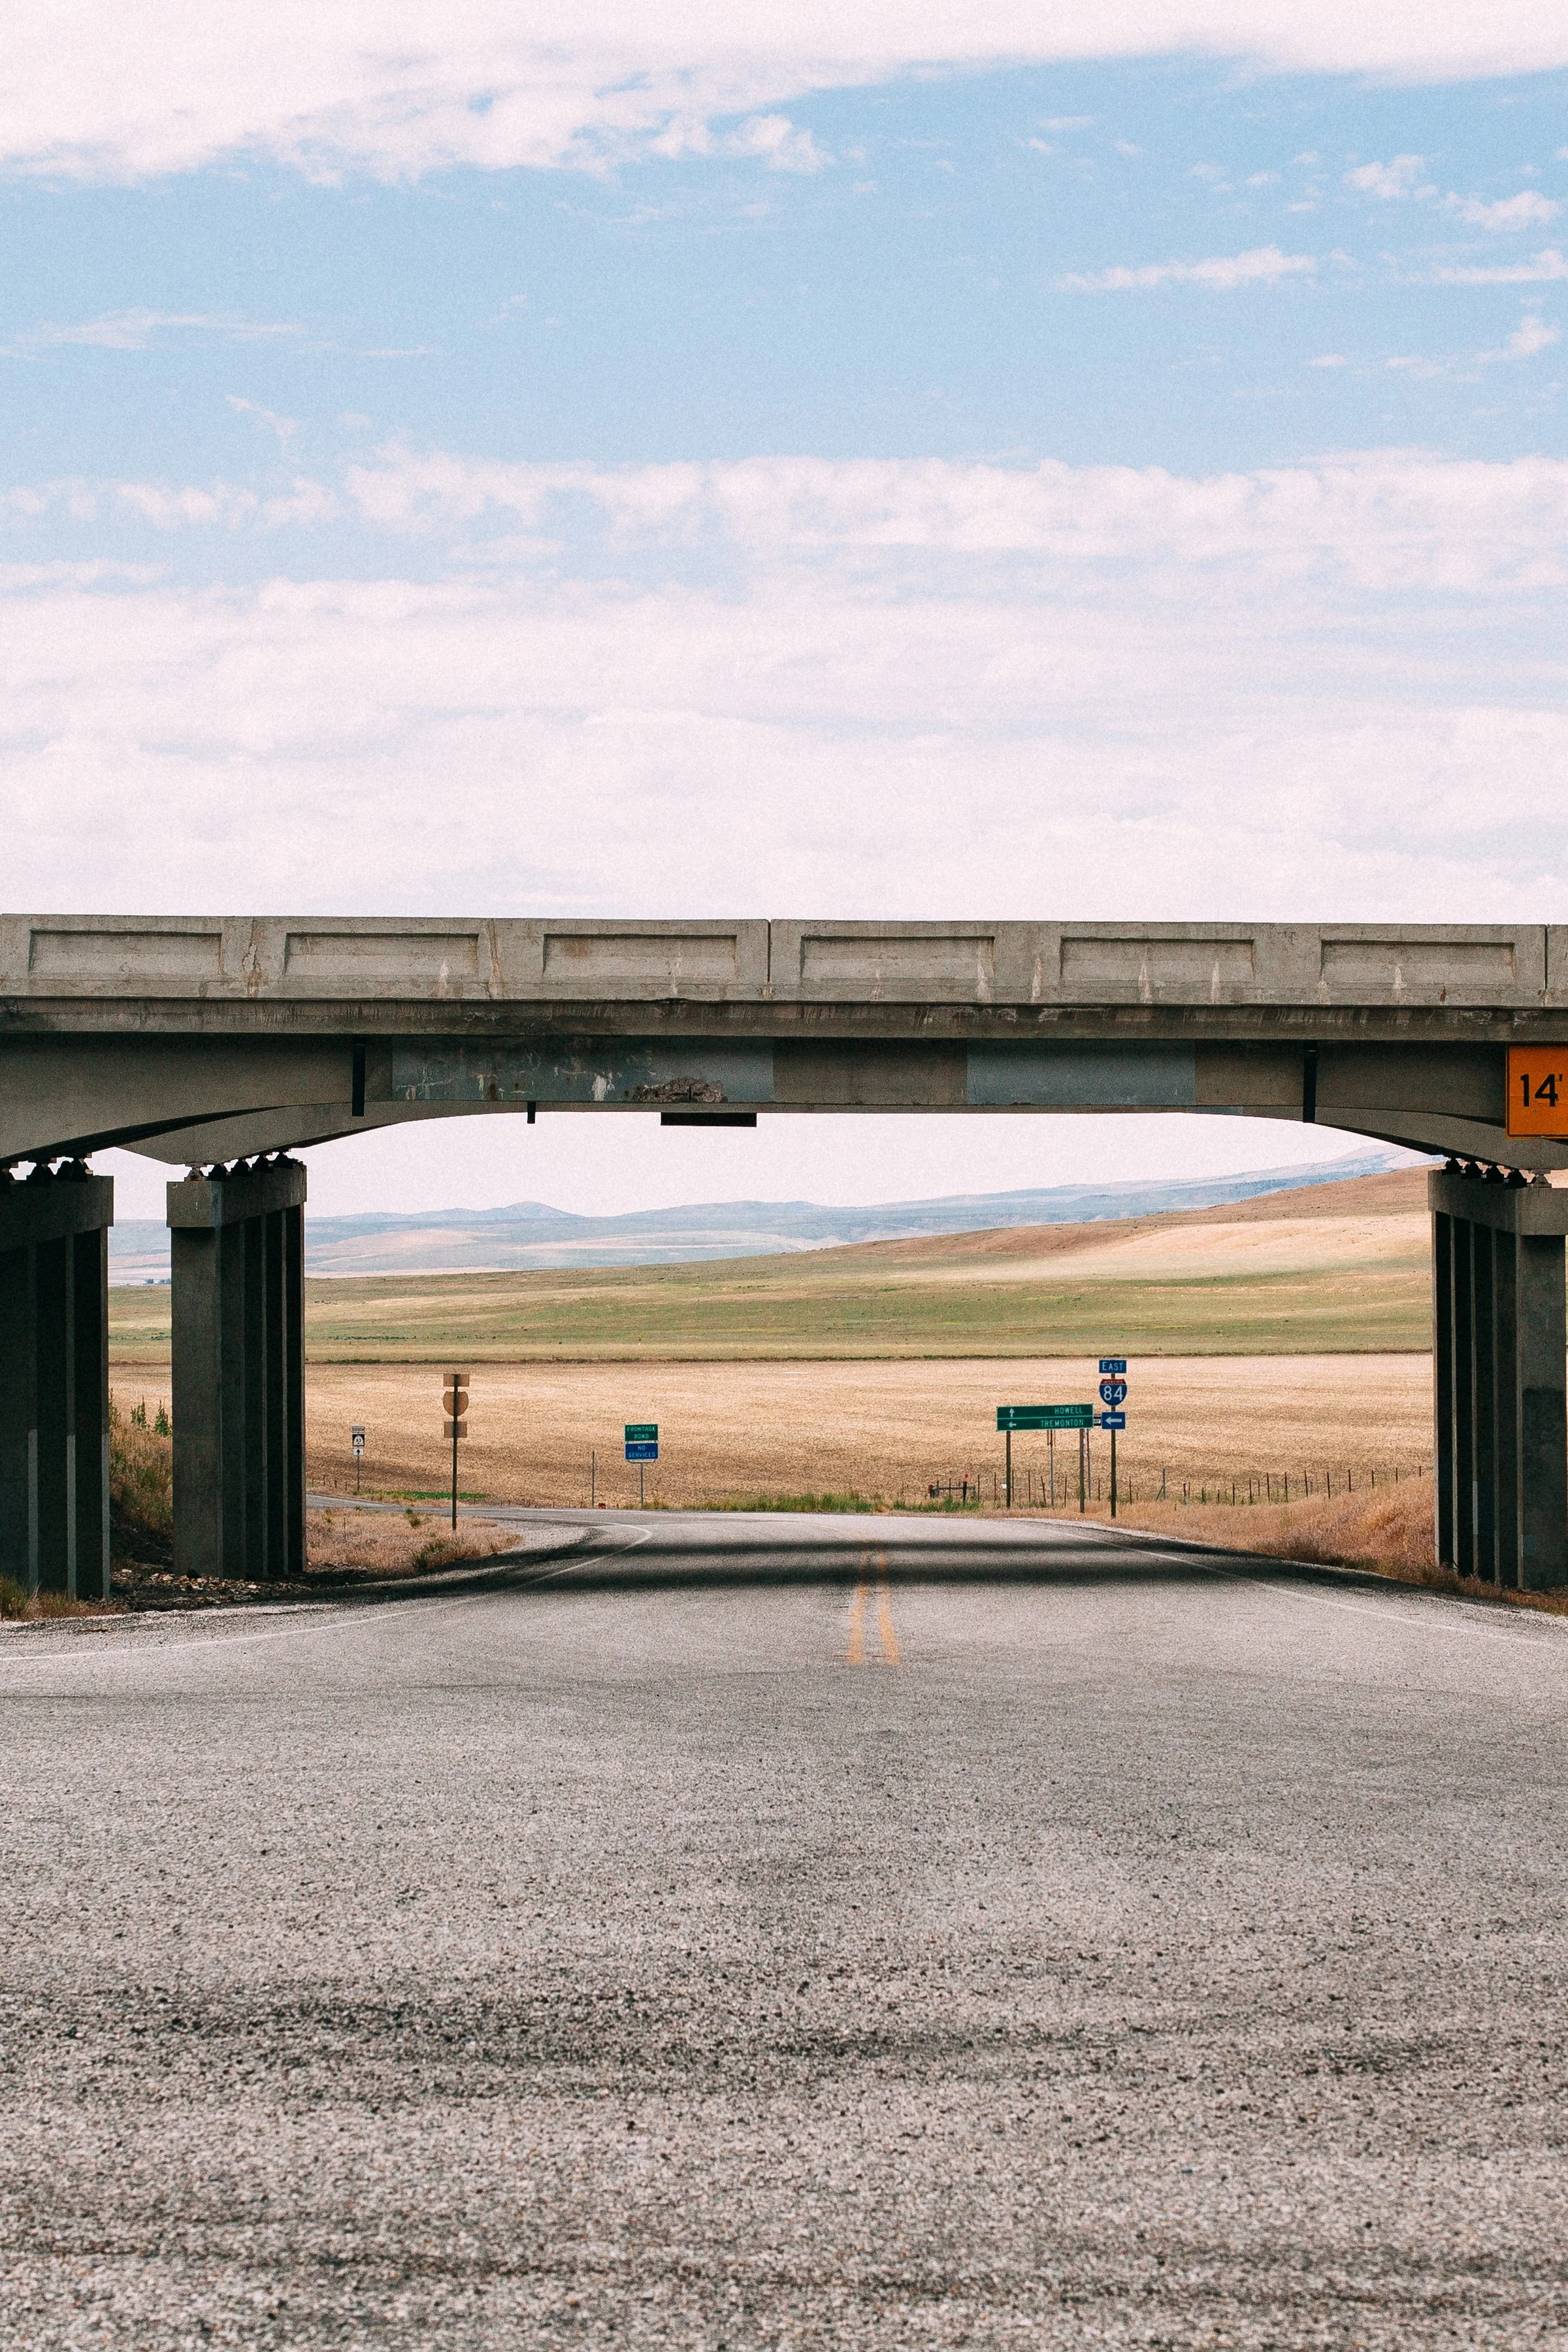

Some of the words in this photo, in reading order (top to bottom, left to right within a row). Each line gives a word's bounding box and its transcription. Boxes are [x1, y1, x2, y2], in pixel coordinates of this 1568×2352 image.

[1520, 1073, 1563, 1107] 14'
[1102, 1362, 1123, 1371] EAST
[1103, 1386, 1123, 1401] 84
[1040, 1419, 1084, 1428] TREMONTON
